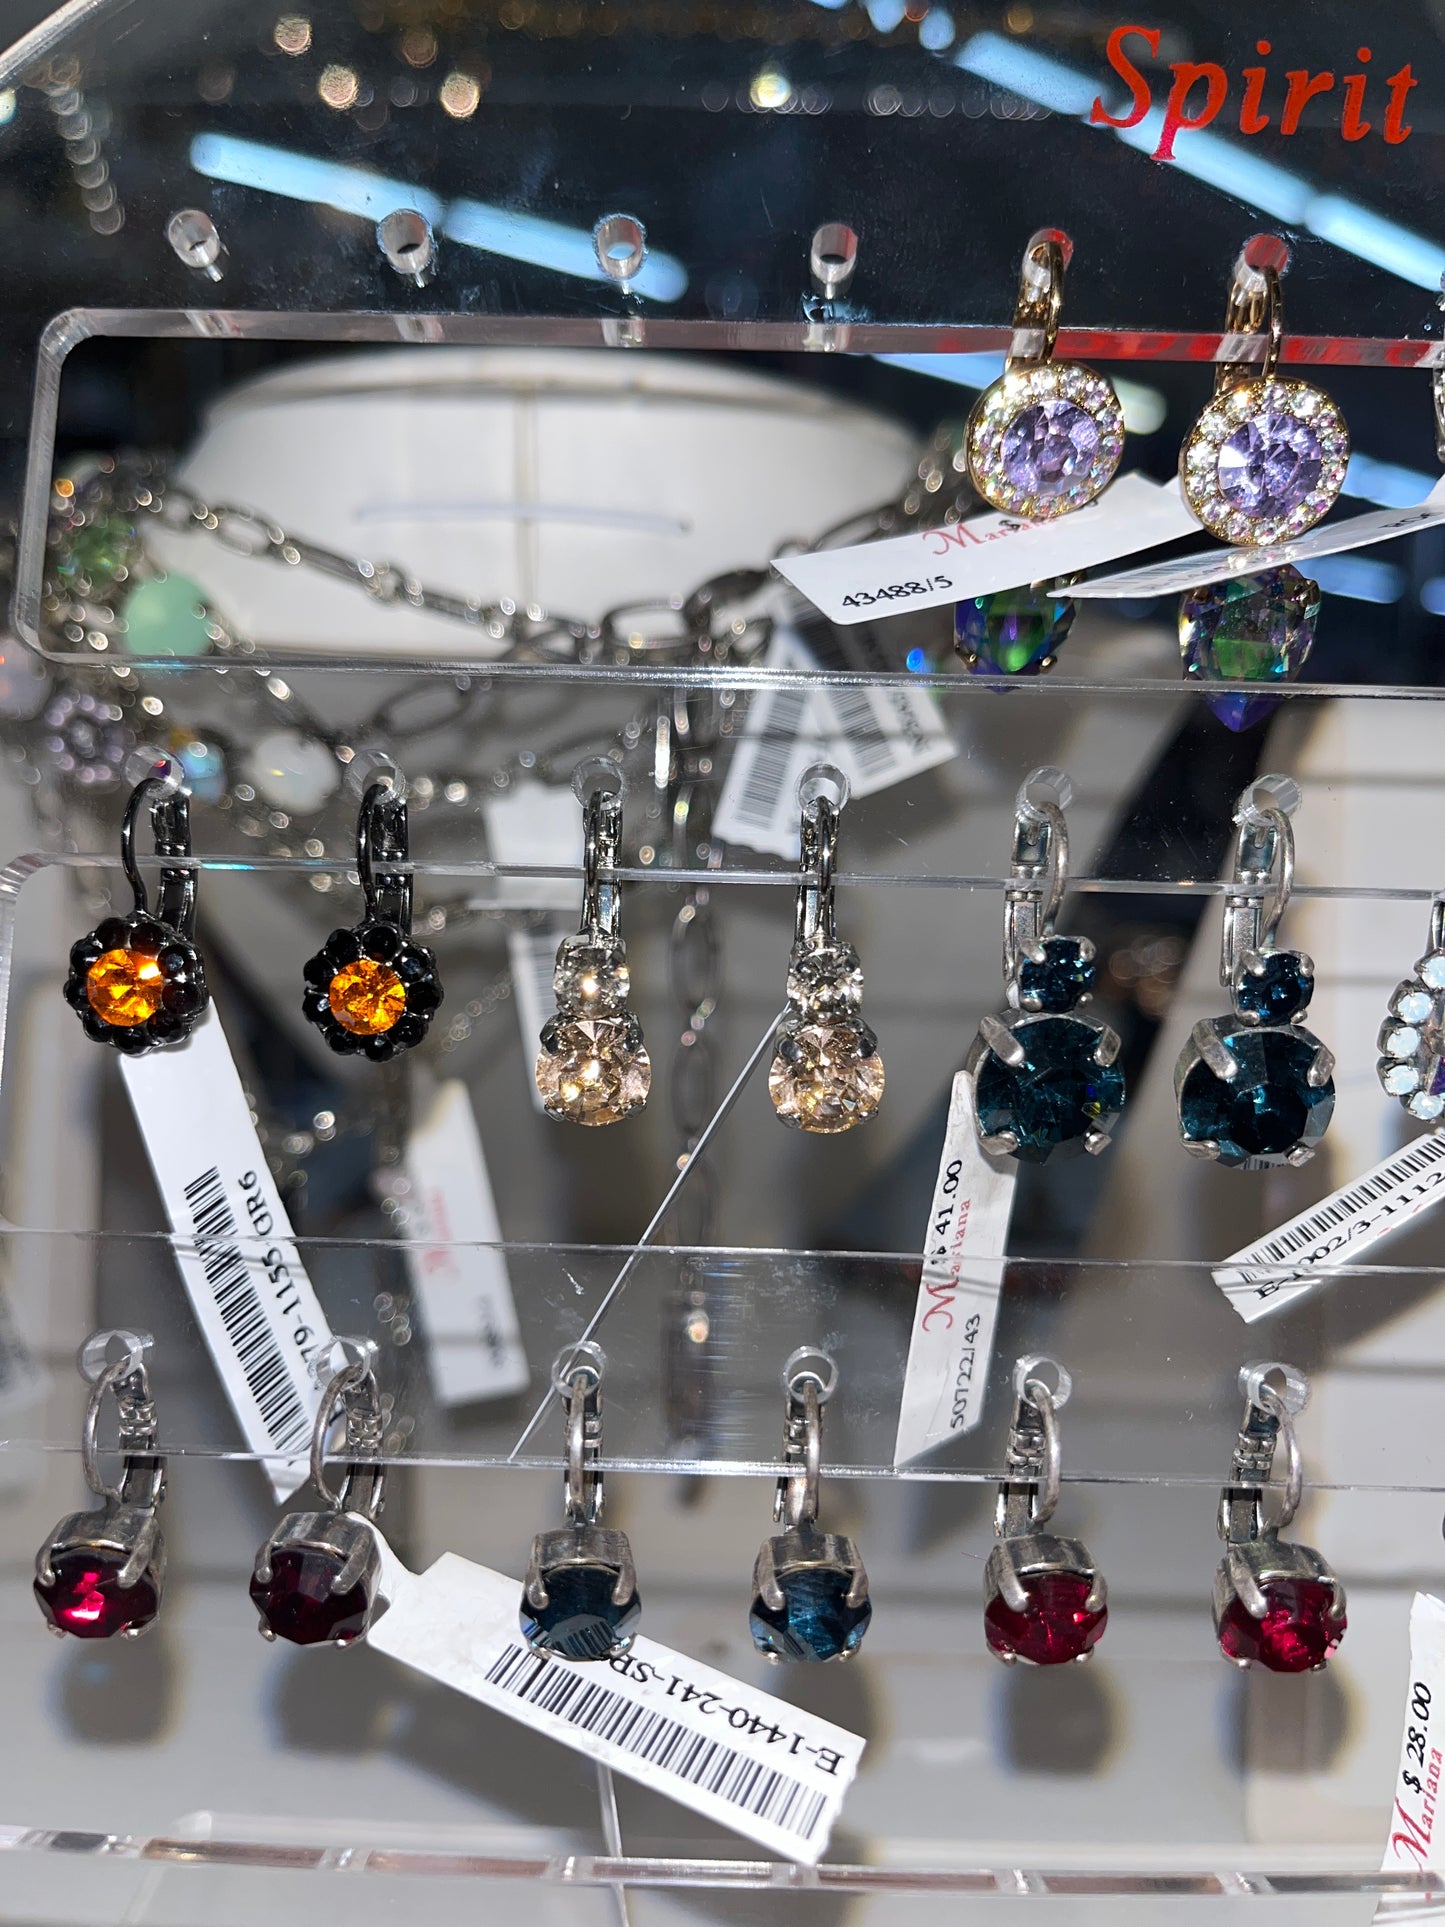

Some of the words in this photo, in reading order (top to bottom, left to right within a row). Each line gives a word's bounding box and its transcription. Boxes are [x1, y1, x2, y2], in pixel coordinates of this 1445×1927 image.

[1090, 25, 1418, 161] Spirit
[842, 575, 953, 608] 43488/5
[935, 1160, 962, 1235] 41.00
[951, 1313, 981, 1429] 50722/43
[1405, 1682, 1432, 1768] 28.00
[1392, 1746, 1443, 1874] Mariana
[1402, 1770, 1423, 1794] $
